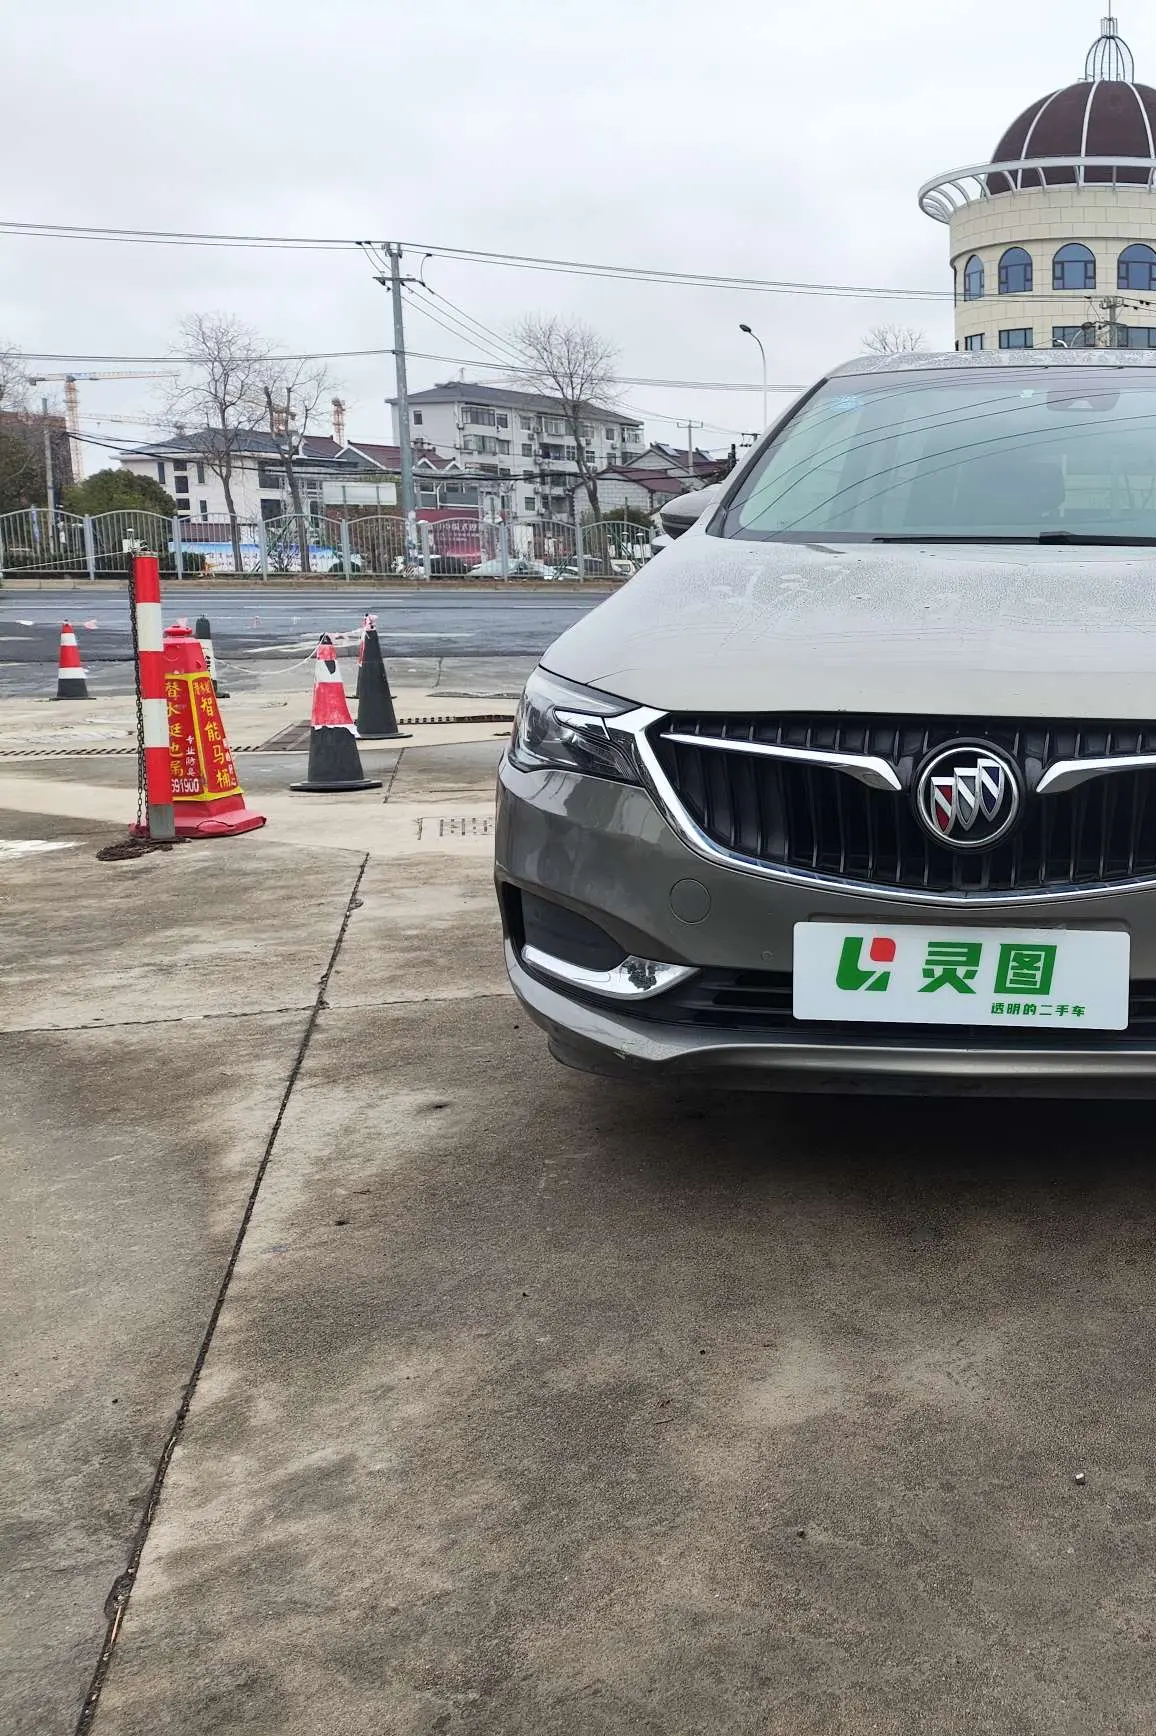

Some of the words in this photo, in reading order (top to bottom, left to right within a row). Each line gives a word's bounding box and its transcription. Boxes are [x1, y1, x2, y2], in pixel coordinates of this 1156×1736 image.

[201, 697, 231, 789] 智能马桶
[918, 941, 1057, 995] 灵图
[990, 1001, 1085, 1017] 透明的二手车
